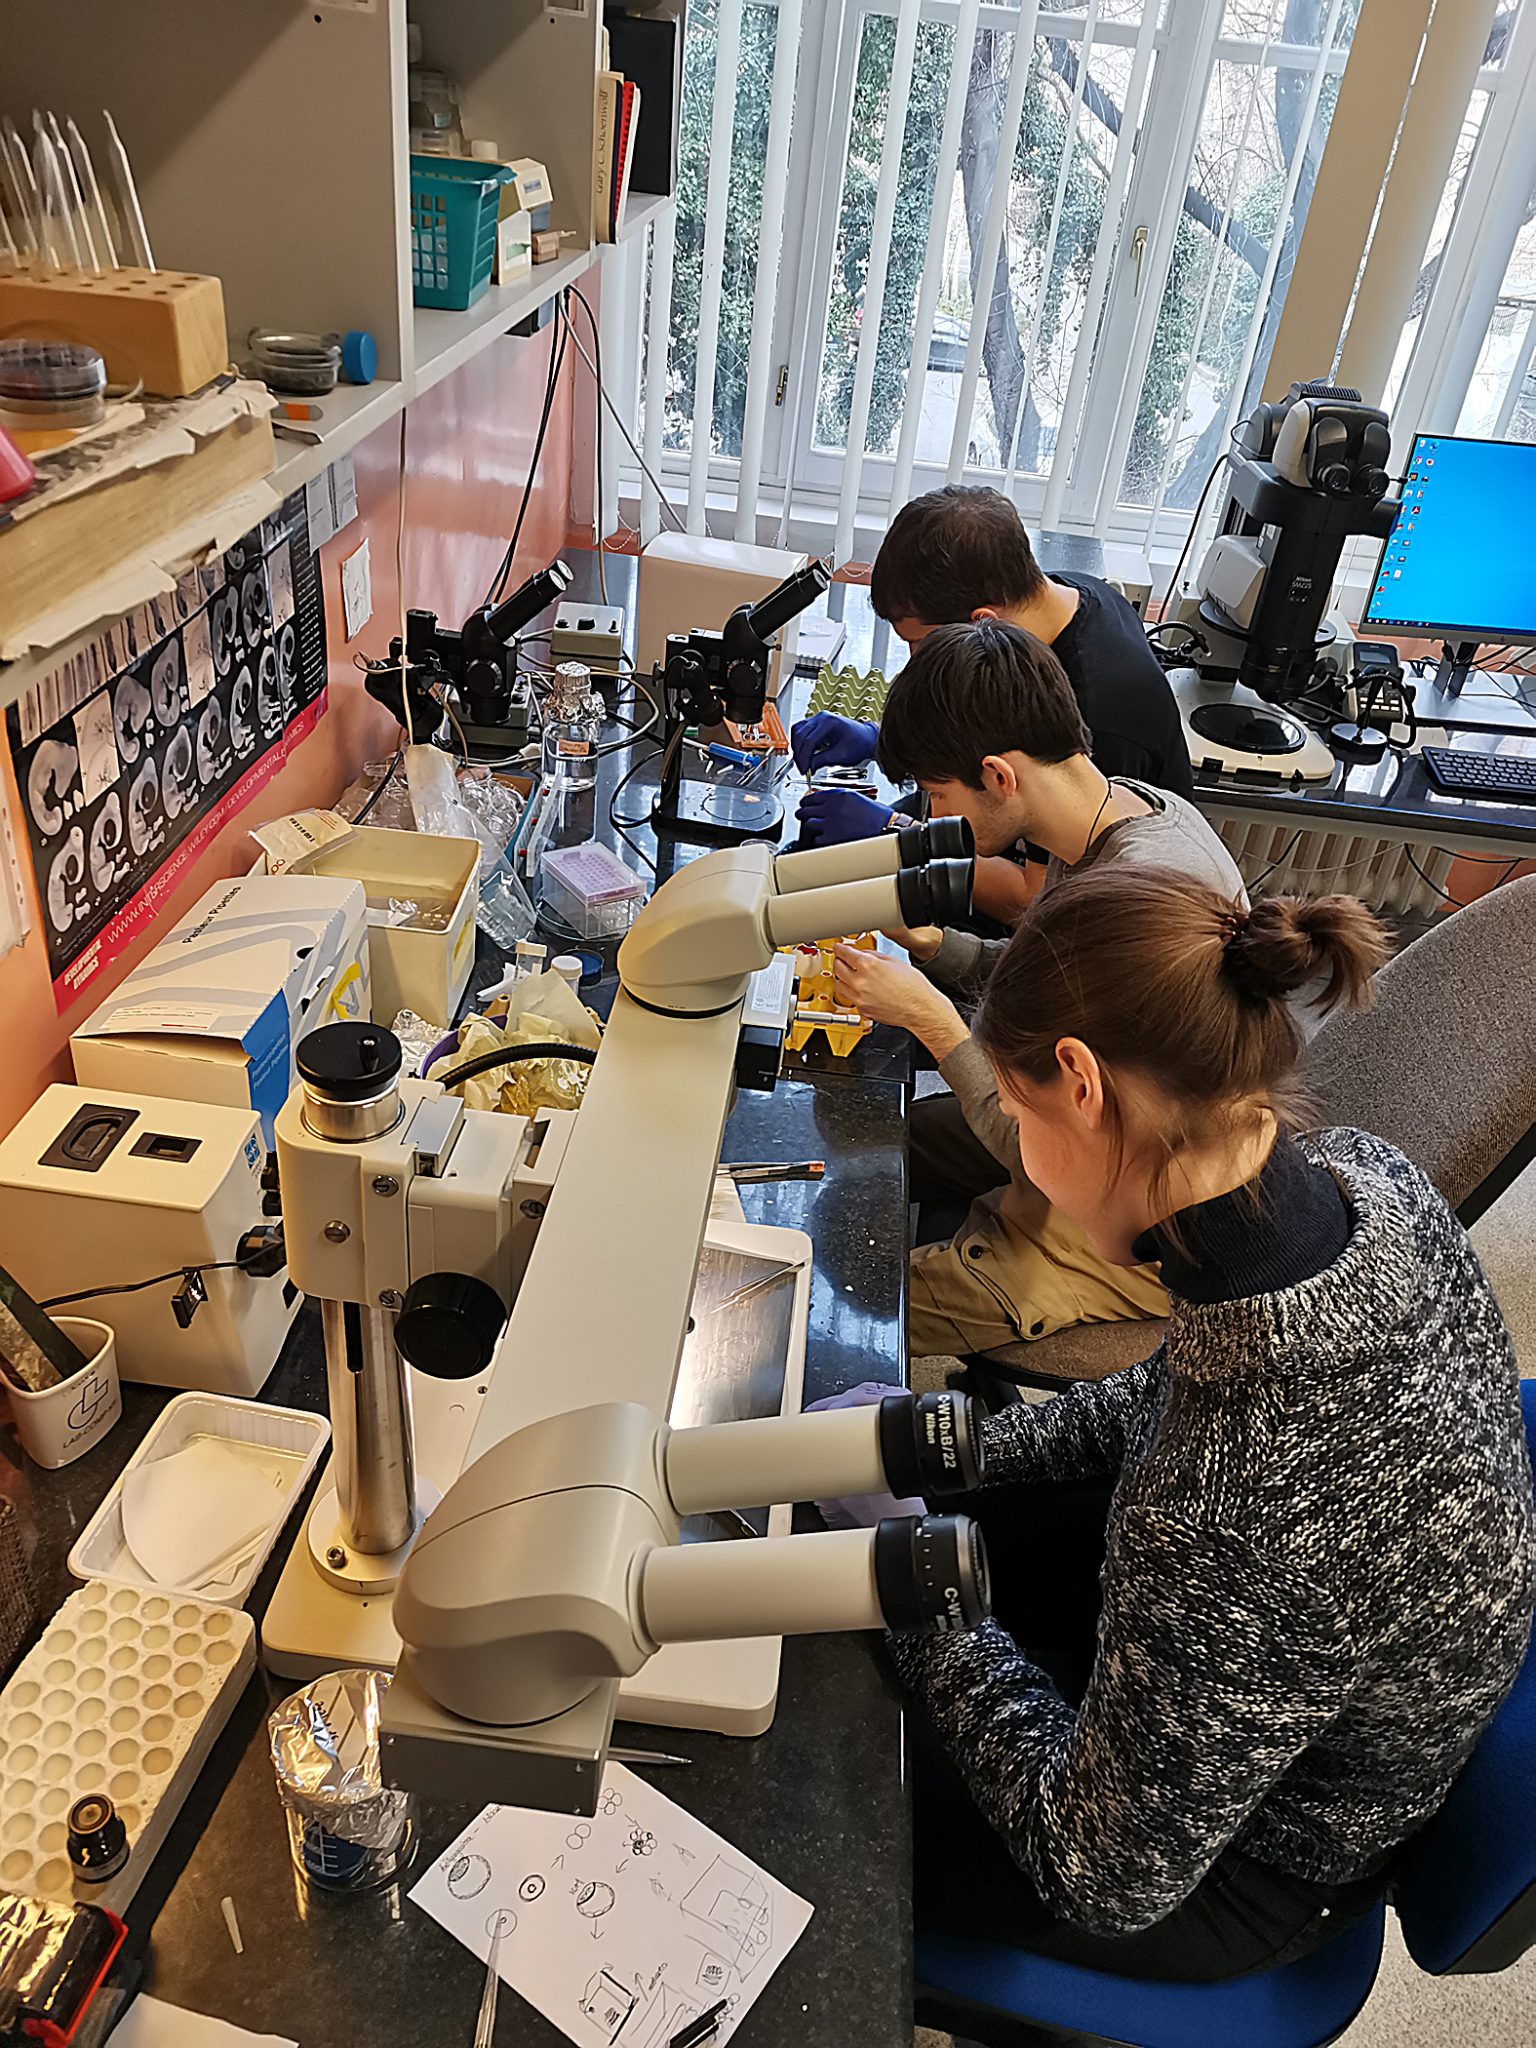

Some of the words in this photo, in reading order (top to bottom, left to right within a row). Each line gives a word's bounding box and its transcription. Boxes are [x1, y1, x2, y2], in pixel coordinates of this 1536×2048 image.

[182, 916, 215, 943] Pasteur
[208, 886, 242, 915] Pipettes
[925, 1412, 936, 1445] Nikon
[937, 1394, 957, 1469] C-W10xB/22
